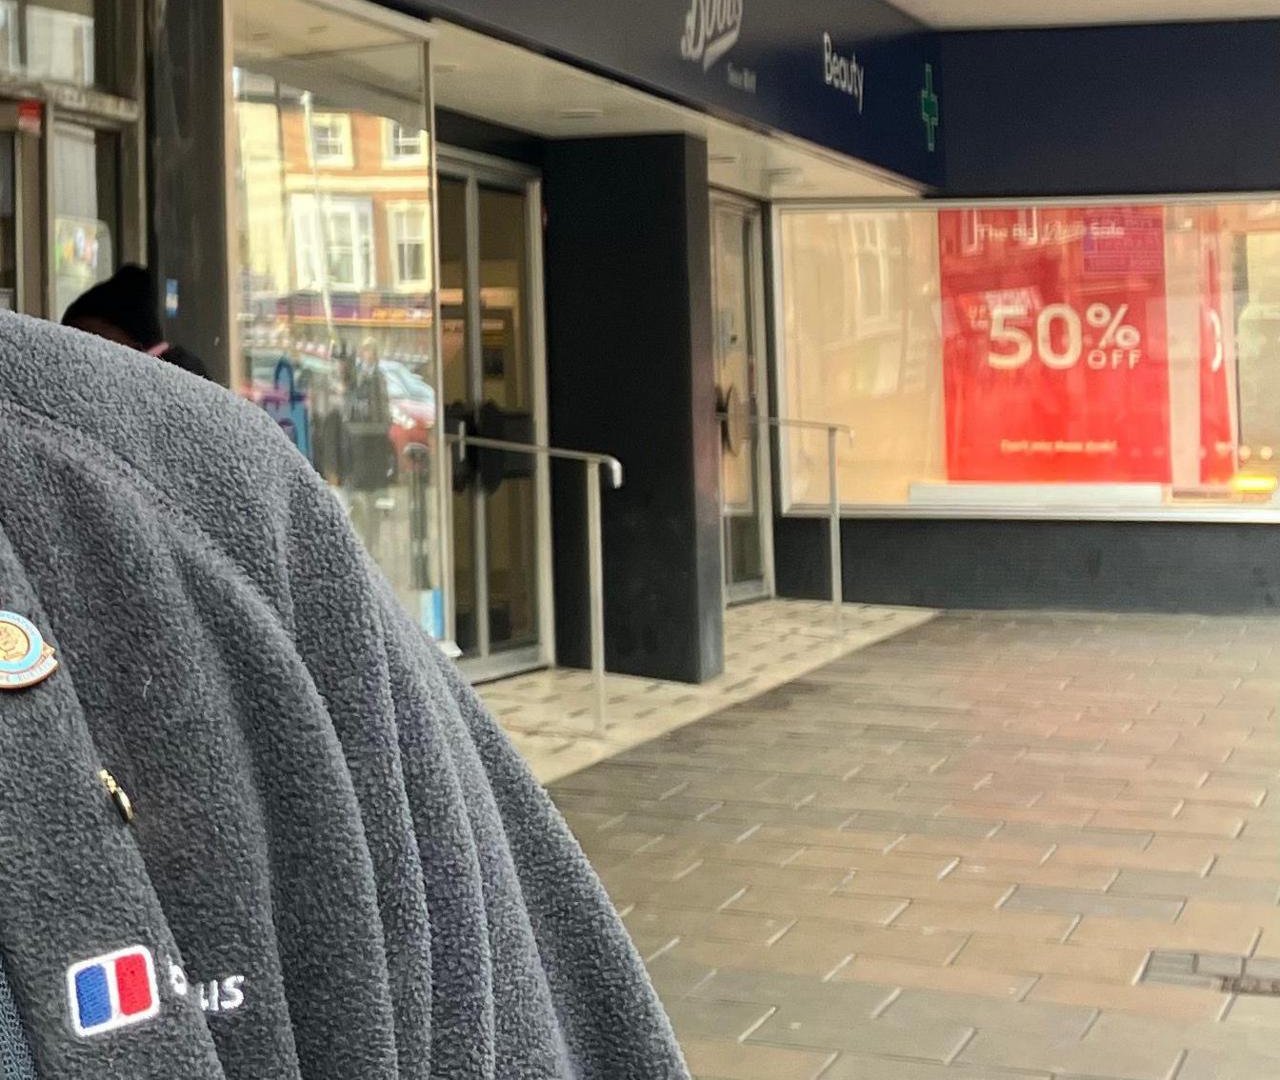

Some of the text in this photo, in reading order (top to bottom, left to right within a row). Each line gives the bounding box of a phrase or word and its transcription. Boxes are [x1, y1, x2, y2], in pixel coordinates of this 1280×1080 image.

[823, 31, 865, 115] Beauty
[988, 302, 1141, 370] 50%
[1087, 349, 1141, 370] OFF
